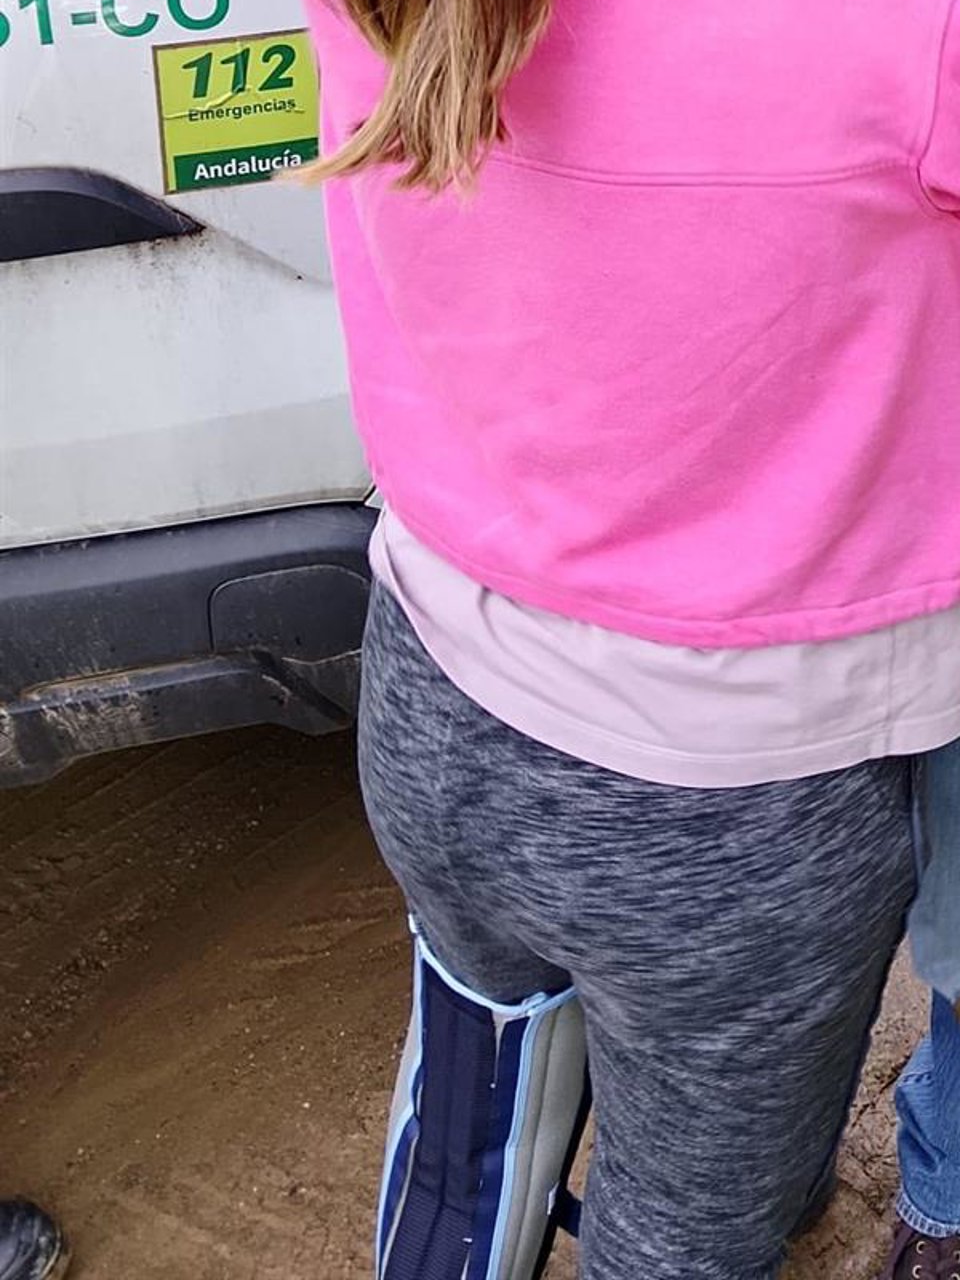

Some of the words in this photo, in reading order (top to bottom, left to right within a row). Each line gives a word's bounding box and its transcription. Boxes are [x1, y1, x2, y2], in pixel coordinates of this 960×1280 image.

[182, 44, 296, 98] 112
[188, 98, 297, 122] Emergencias
[194, 149, 302, 180] Andalucía
